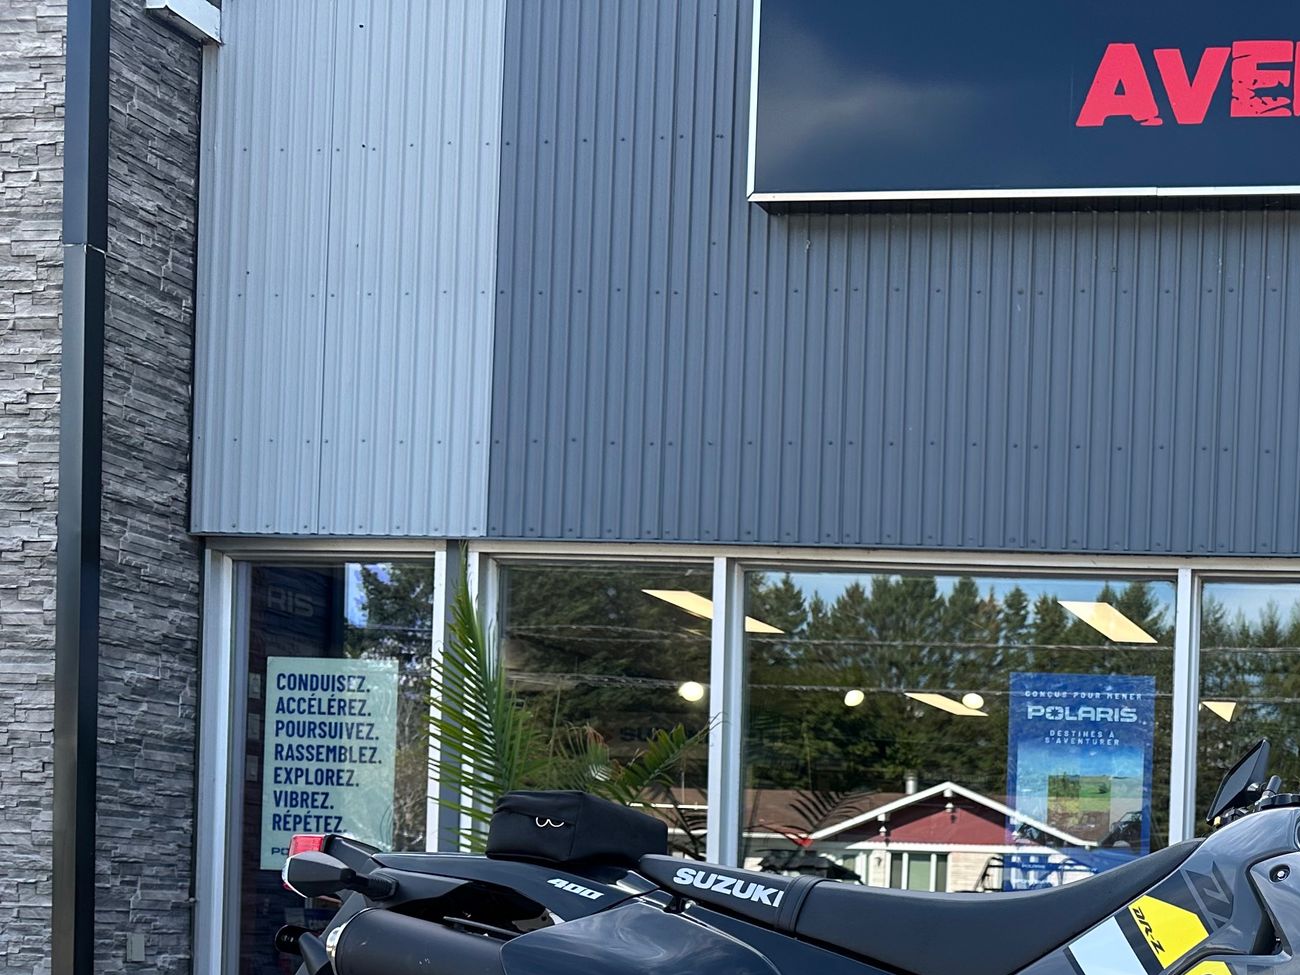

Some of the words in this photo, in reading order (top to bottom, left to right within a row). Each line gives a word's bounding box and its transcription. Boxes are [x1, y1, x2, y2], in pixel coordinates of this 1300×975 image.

[276, 672, 371, 693] CONDUISEZ.
[275, 693, 372, 717] ACCÉLÉREZ.
[1027, 704, 1138, 723] POLARIS
[274, 719, 379, 741] POURSUIVEZ.
[274, 743, 382, 765] RASSEMBLEZ.
[273, 766, 360, 788] EXPLOREZ.
[273, 790, 334, 810] VIBREZ.
[271, 809, 347, 833] RÉPÉTEZ.
[547, 878, 605, 900] 400
[672, 866, 785, 908] SUZUKI
[1132, 906, 1166, 955] DR-Z
